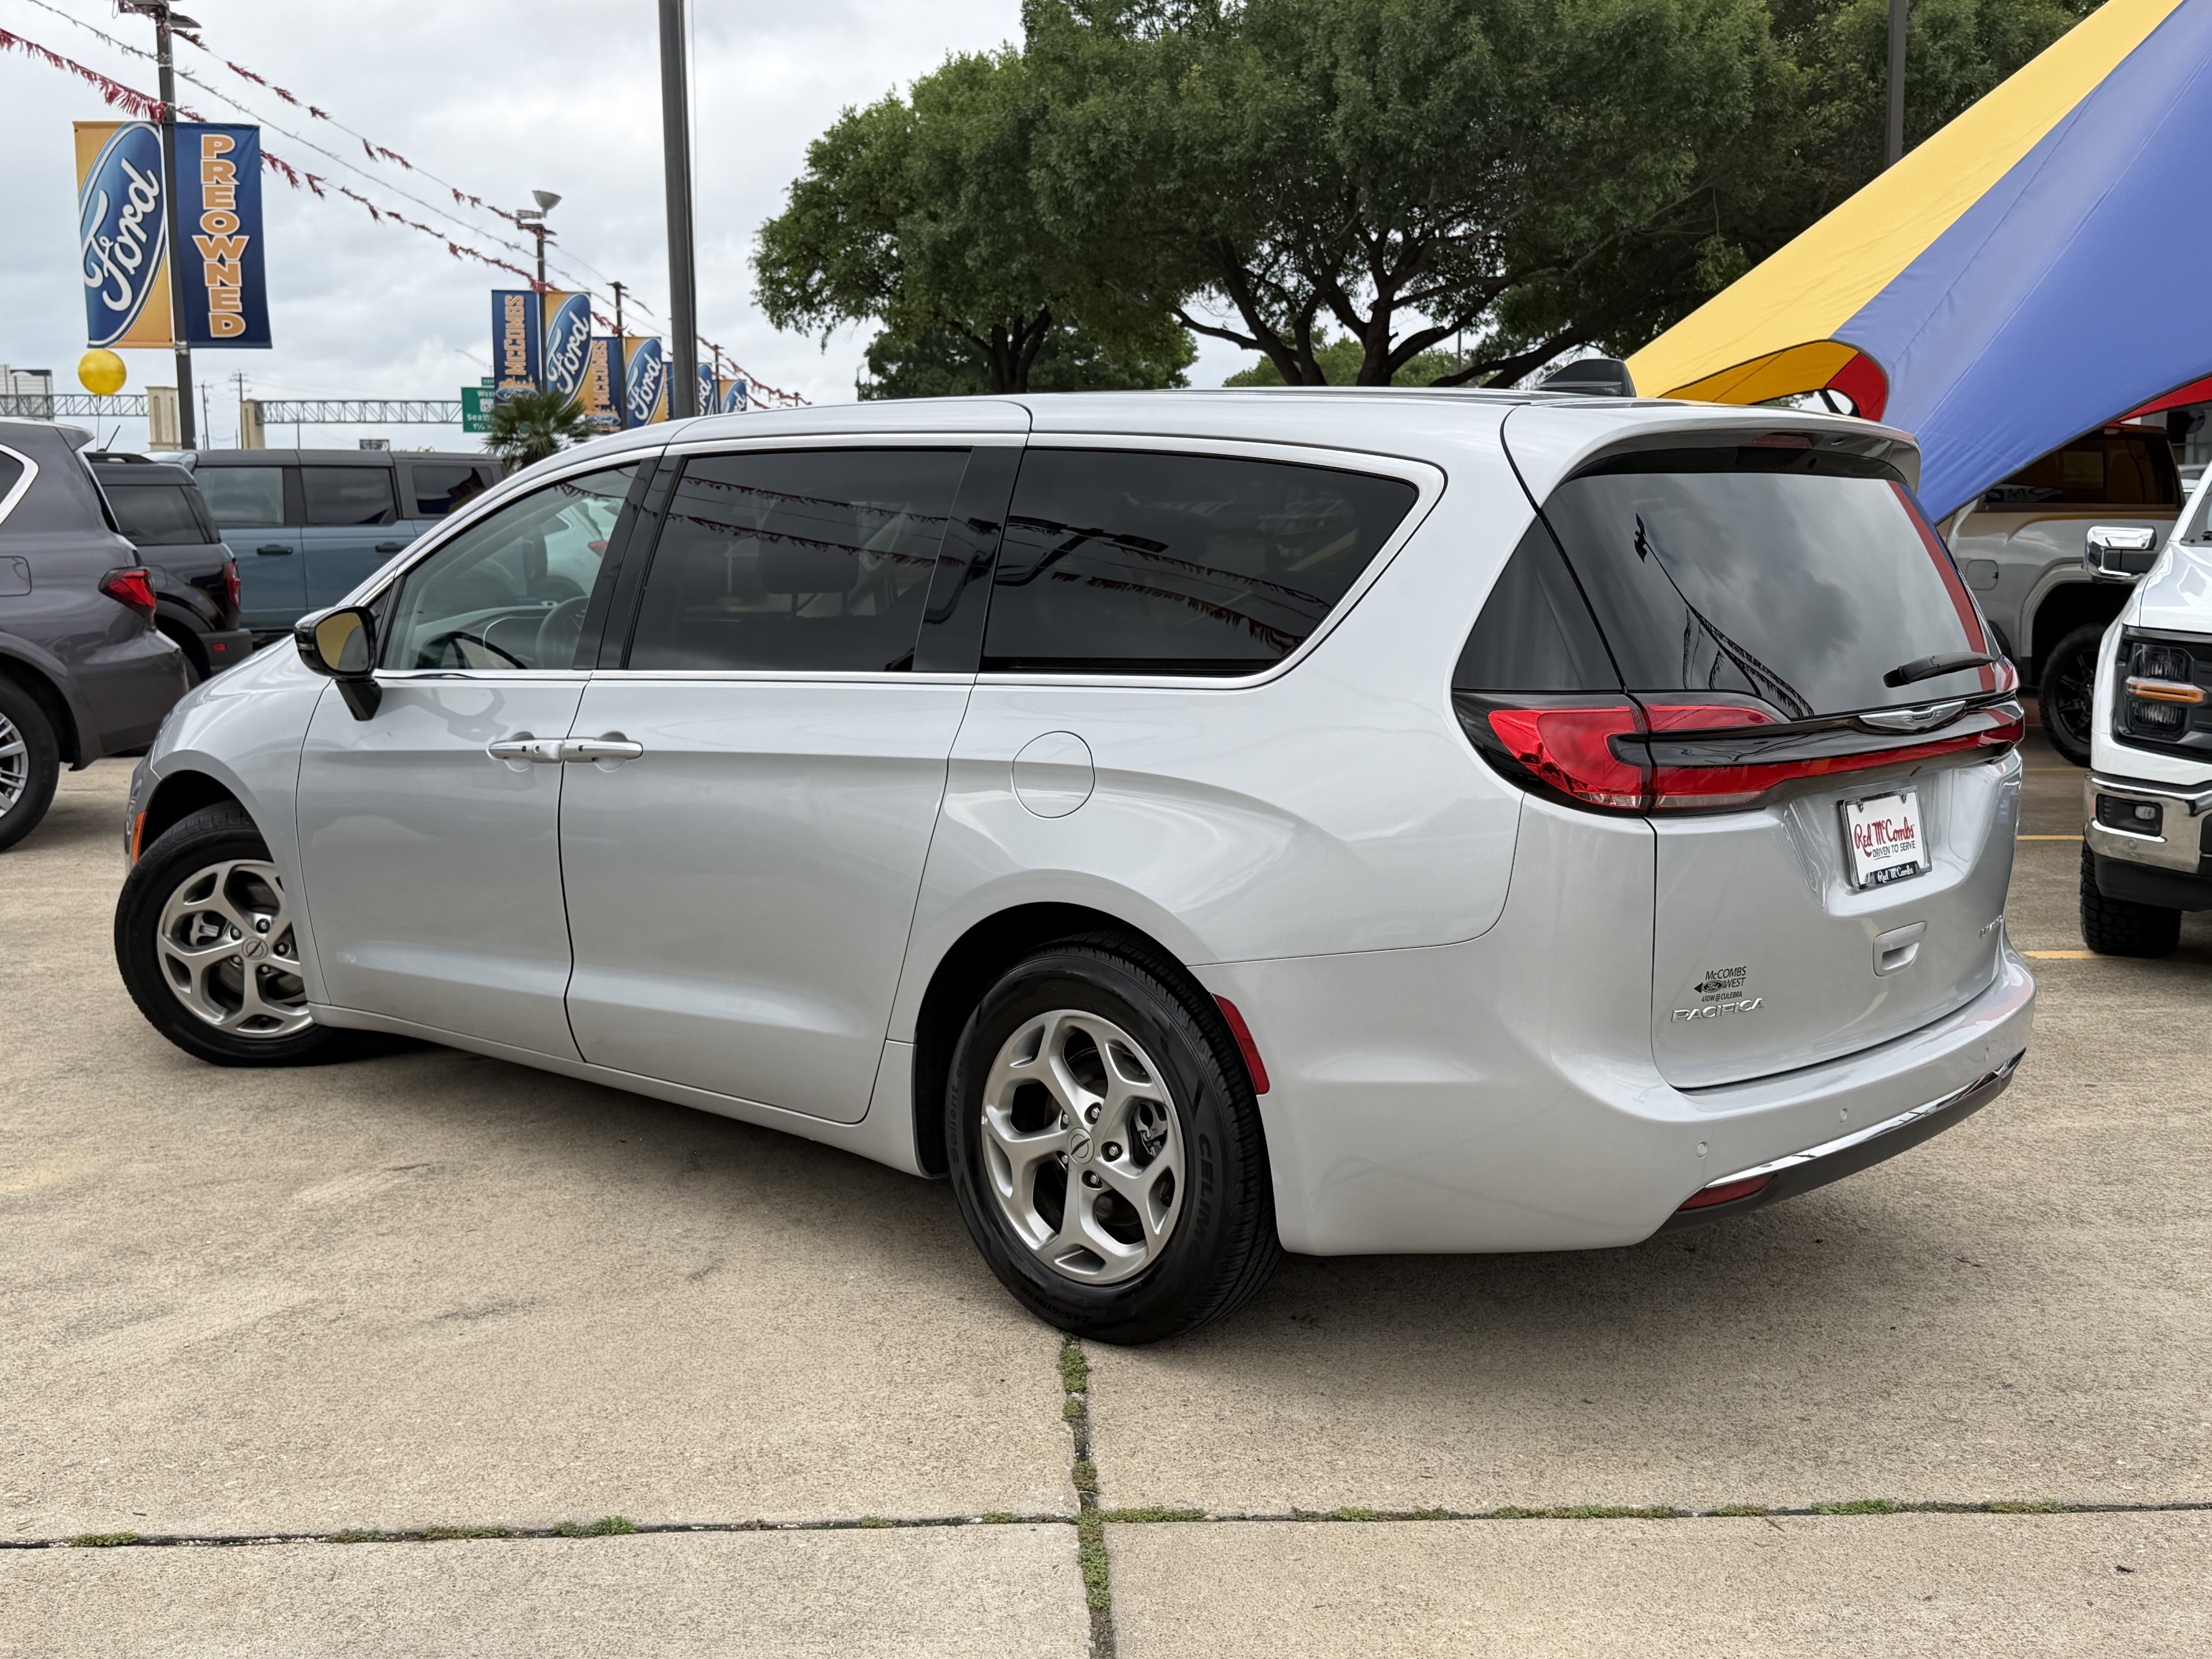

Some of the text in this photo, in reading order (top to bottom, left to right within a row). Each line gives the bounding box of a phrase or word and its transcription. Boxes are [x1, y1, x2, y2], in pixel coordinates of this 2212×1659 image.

[84, 158, 159, 311] Ford
[192, 134, 250, 338] PREOWNED
[547, 310, 589, 394] Ford
[627, 352, 661, 421] Ford
[1854, 816, 1914, 857] Red McCombs
[1872, 840, 1915, 858] DRIVEN TO SERVE
[1705, 966, 1747, 981] McCOMBS
[1724, 977, 1746, 988] WEST
[1671, 998, 1764, 1022] PACIFICA
